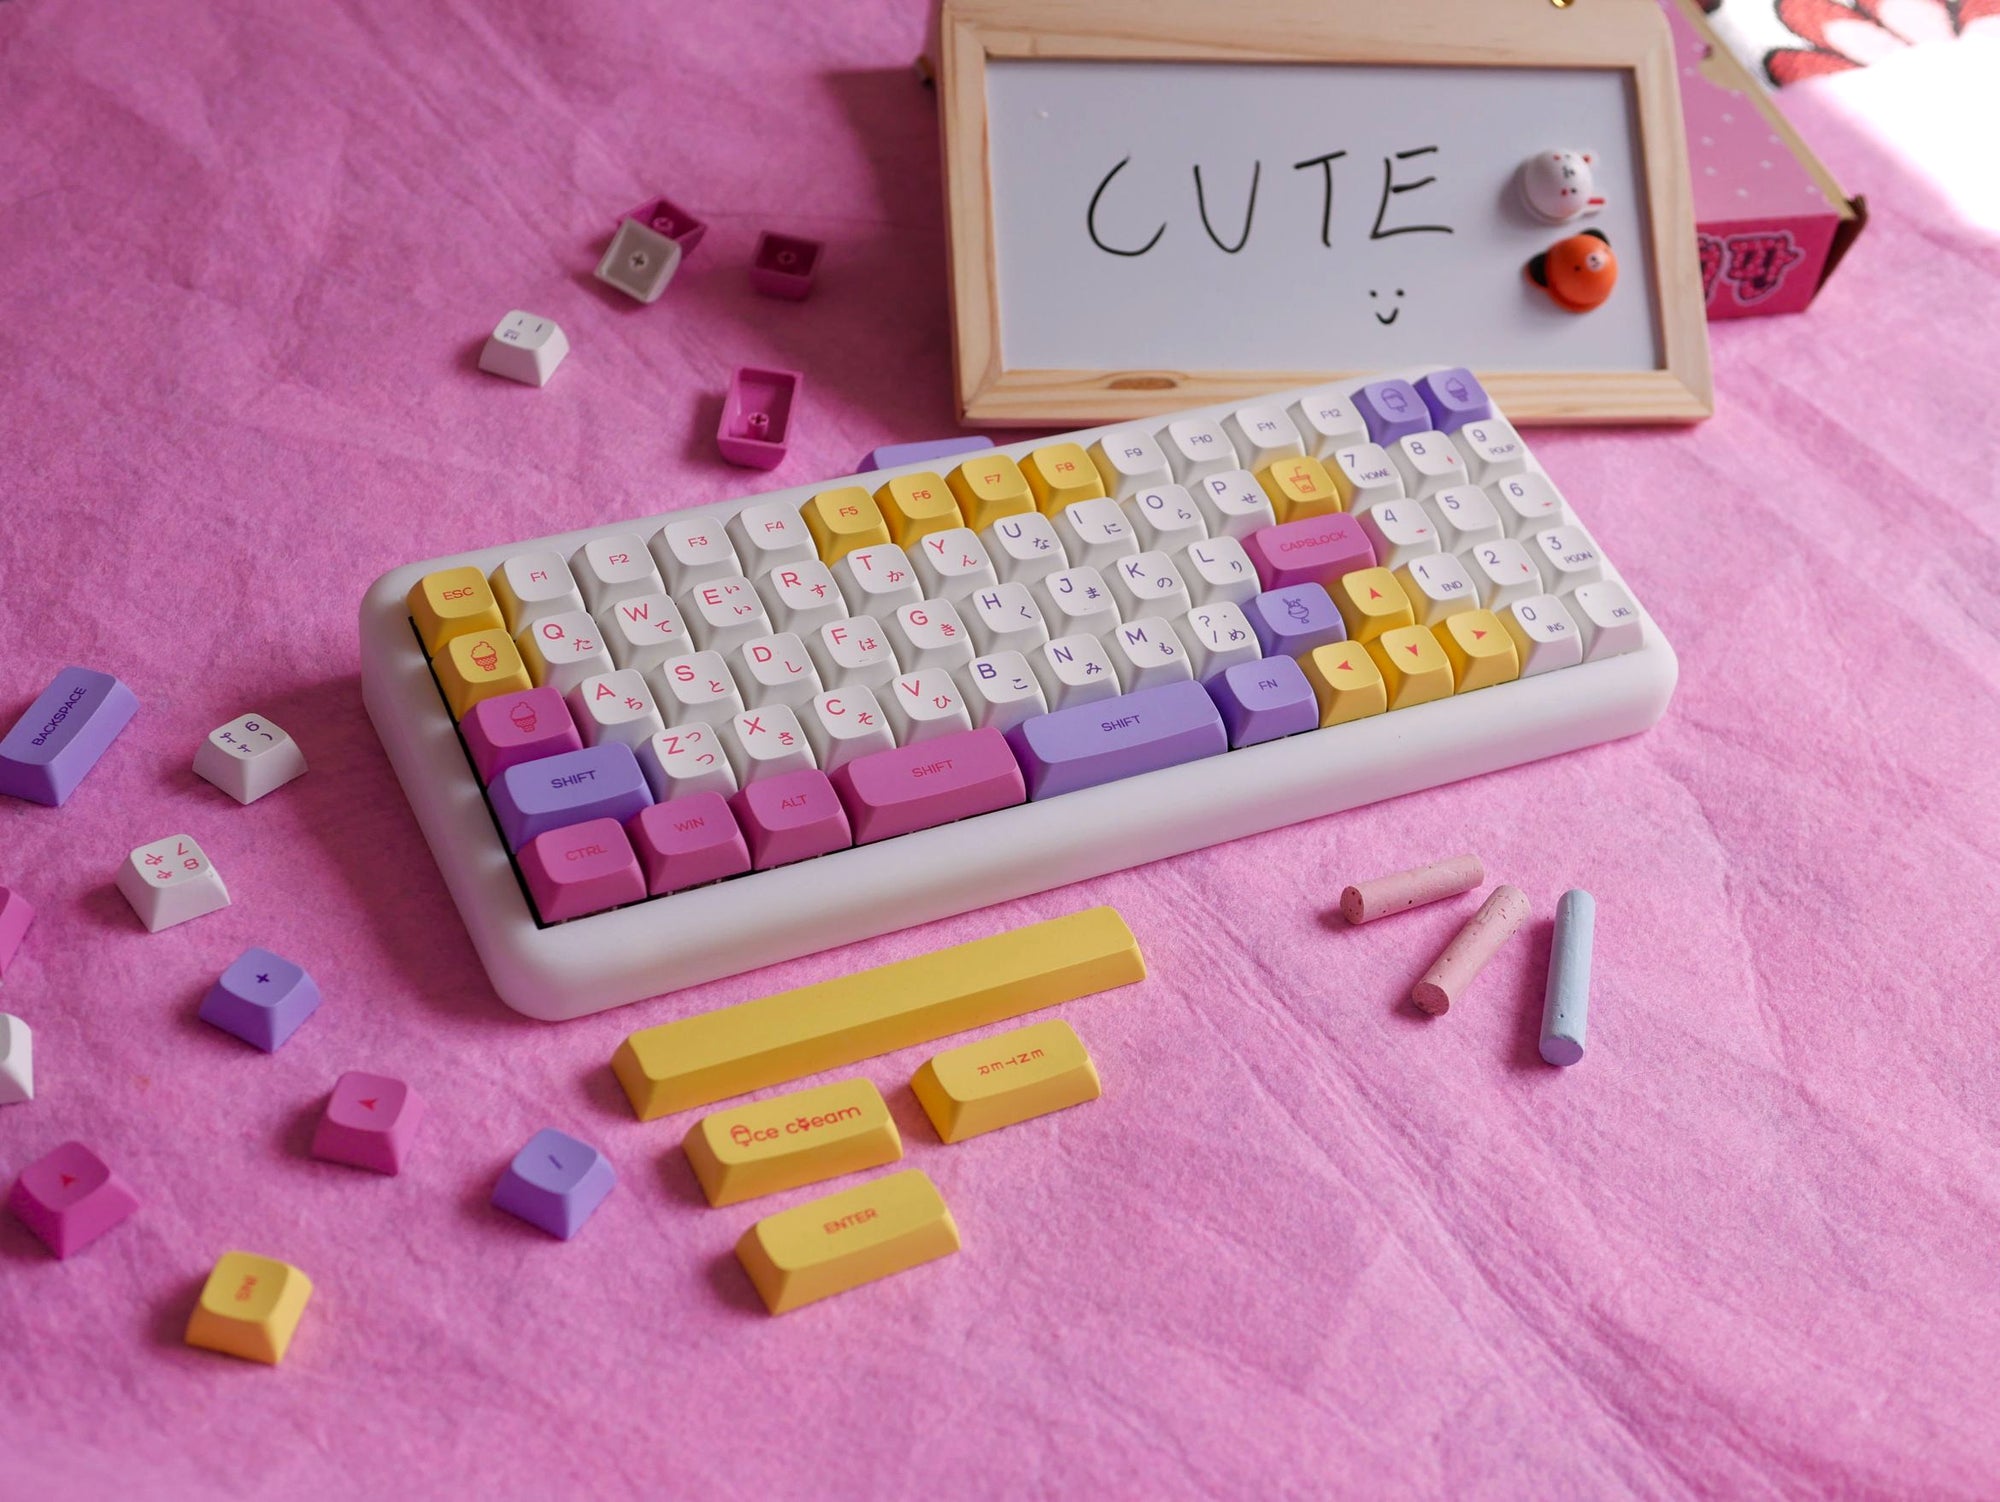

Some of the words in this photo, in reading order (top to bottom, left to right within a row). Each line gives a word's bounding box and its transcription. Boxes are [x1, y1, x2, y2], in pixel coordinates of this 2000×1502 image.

[1087, 146, 1453, 257] CUTE
[1320, 409, 1342, 419] F12
[1190, 434, 1213, 445] F10
[1473, 429, 1487, 442] 9
[1125, 448, 1142, 458] F9
[1410, 442, 1426, 455] 8
[1055, 462, 1075, 472] F8
[1343, 454, 1355, 468] 7
[984, 474, 1000, 484] F7
[1360, 469, 1389, 480] HOME
[1212, 481, 1226, 494] P
[1510, 483, 1524, 496] 6
[912, 490, 931, 501] F6
[1146, 495, 1163, 509] O
[1445, 496, 1460, 509] 5
[839, 506, 858, 517] F5
[1385, 509, 1397, 522] 4
[765, 521, 784, 532] F4
[1002, 523, 1021, 538] U
[688, 536, 707, 547] F3
[928, 539, 945, 555] Y
[1279, 530, 1348, 552] CAPSLOCK
[1547, 536, 1562, 550] 3
[609, 554, 629, 565] F2
[856, 555, 871, 570] T
[1195, 548, 1215, 564] L
[1484, 551, 1500, 564] 2
[531, 571, 547, 582] F1
[1125, 562, 1145, 579] K
[1418, 565, 1430, 580] 1
[781, 572, 801, 587] R
[1060, 578, 1073, 593] J
[1442, 581, 1462, 591] END
[443, 587, 474, 600] ESC
[703, 589, 722, 605] E
[982, 593, 1001, 609] H
[623, 604, 647, 621] W
[910, 610, 928, 625] G
[1521, 606, 1537, 622] 0
[1612, 608, 1631, 617] DEL
[543, 624, 565, 639] Q
[1547, 623, 1564, 632] INS
[831, 628, 848, 645] F
[1125, 628, 1147, 645] M
[752, 647, 772, 662] D
[1053, 647, 1073, 663] N
[675, 665, 694, 681] S
[977, 664, 996, 679] B
[596, 683, 616, 700] A
[902, 680, 919, 696] V
[1259, 679, 1278, 690] FN
[826, 699, 845, 715] C
[31, 686, 87, 747] BACKSPACE
[1101, 715, 1140, 731] SHIFT
[744, 717, 766, 735] X
[663, 737, 684, 754] Z
[912, 760, 952, 777] SHIFT
[551, 770, 595, 788] SHIFT
[782, 794, 806, 809] ALT
[673, 817, 704, 832] WIN
[565, 845, 608, 861] CTRL
[823, 1208, 877, 1234] ENTER
